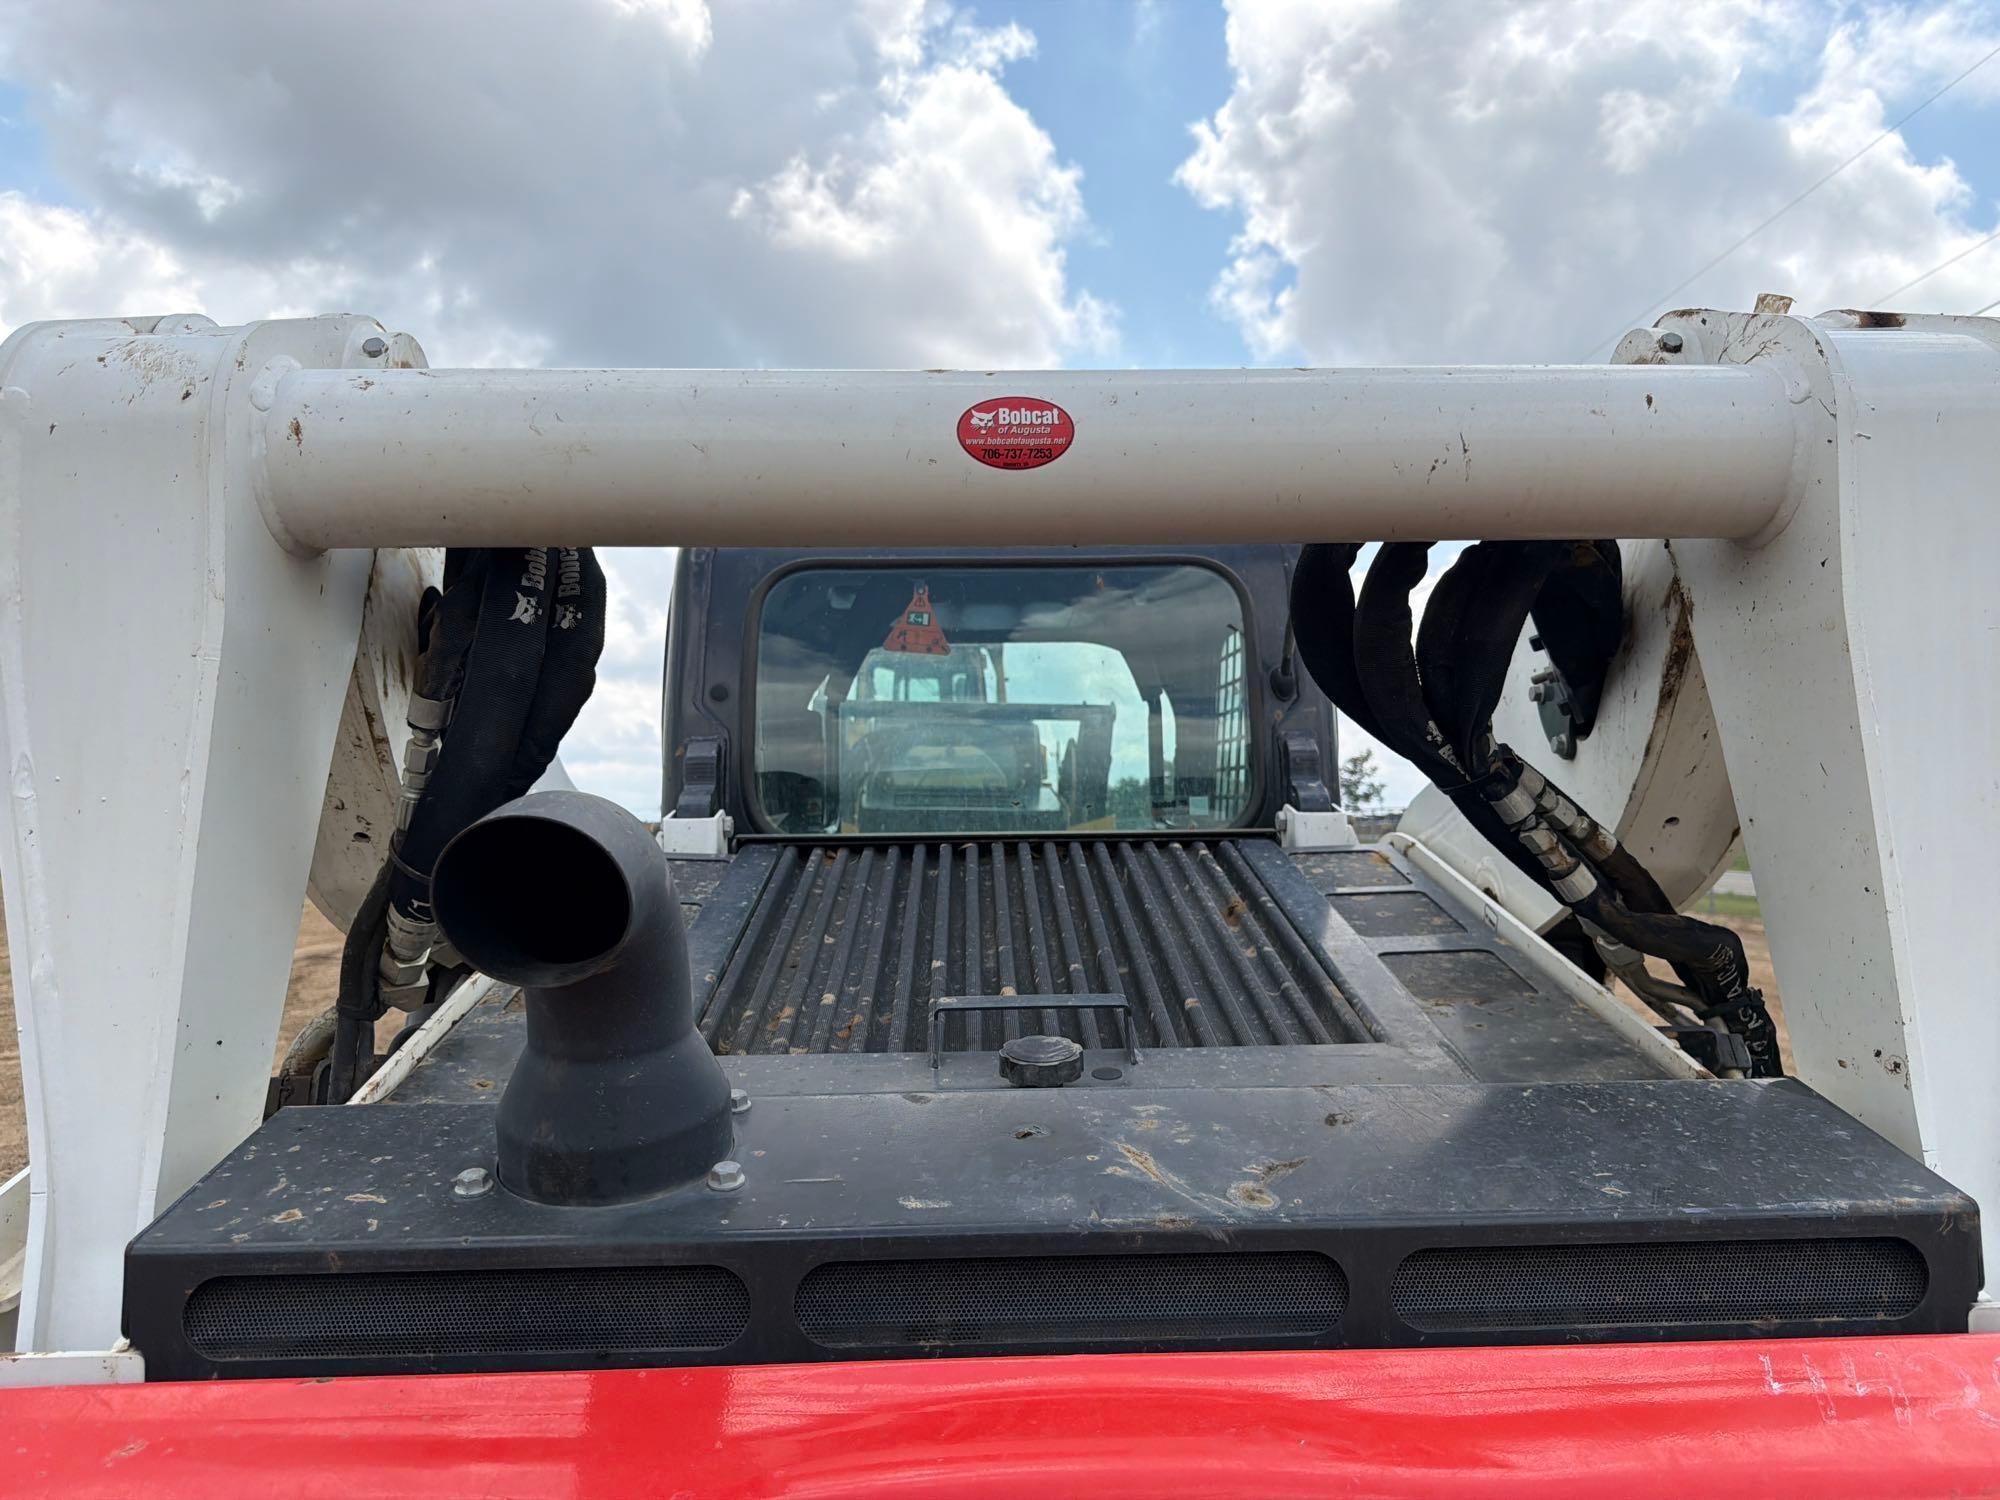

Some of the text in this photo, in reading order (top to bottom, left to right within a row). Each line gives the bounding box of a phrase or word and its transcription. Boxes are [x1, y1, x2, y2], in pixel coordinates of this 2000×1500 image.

[998, 407, 1061, 425] Bobcat
[998, 425, 1051, 436] of Augusta
[965, 436, 1066, 446] www.bobcatofaugusta.net
[981, 448, 1053, 459] 706-737-7253
